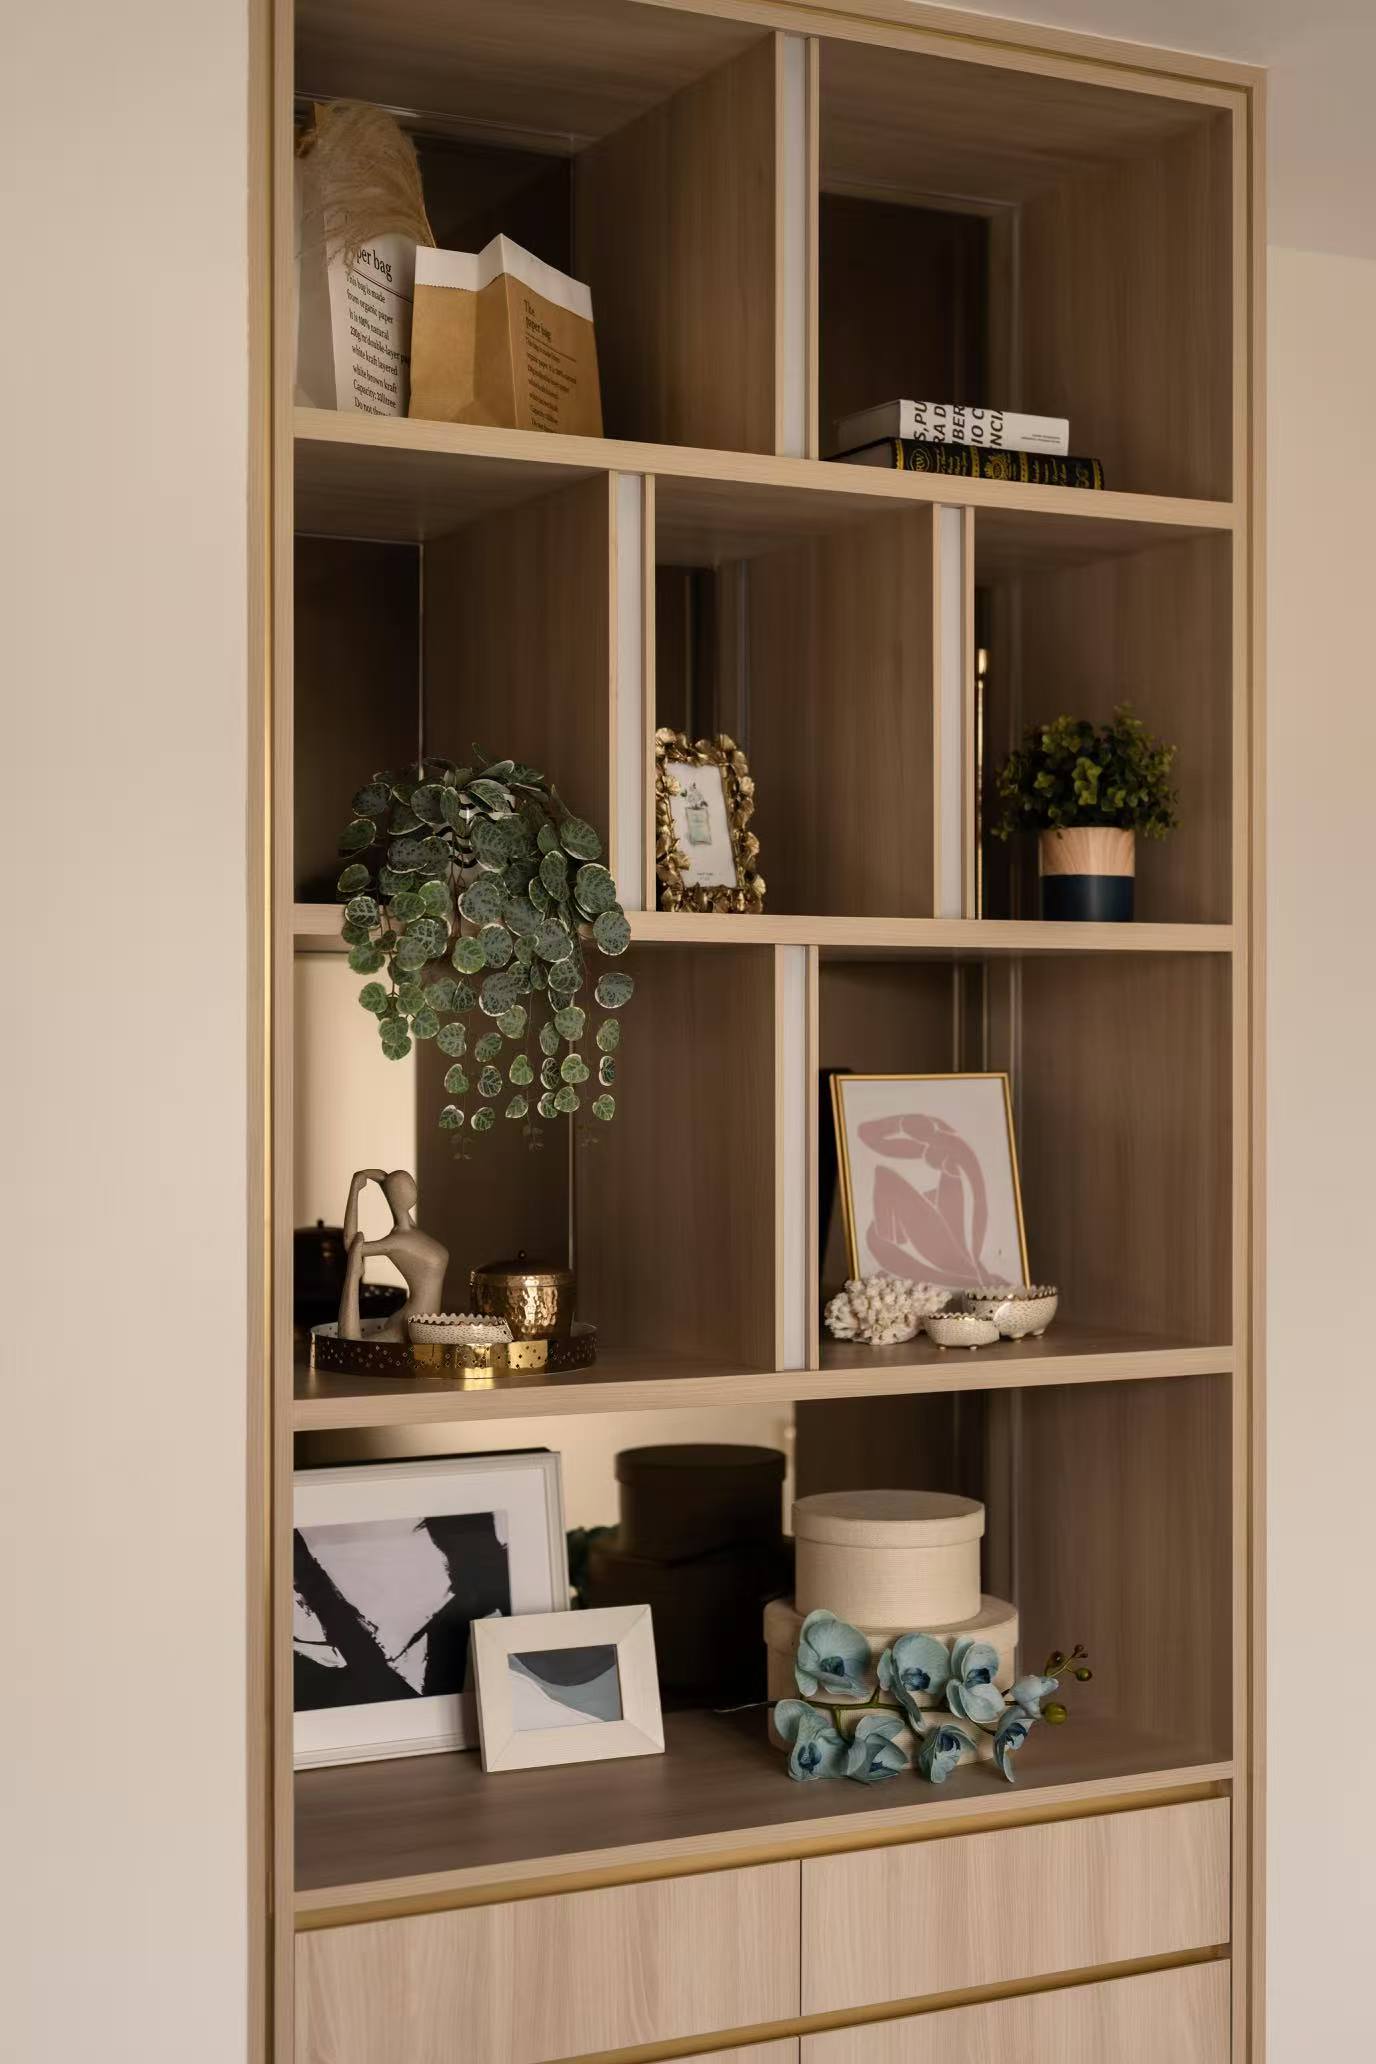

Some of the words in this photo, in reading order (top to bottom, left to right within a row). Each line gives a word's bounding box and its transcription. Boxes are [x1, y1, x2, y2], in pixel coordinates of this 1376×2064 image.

[373, 249, 393, 283] bag
[346, 289, 359, 304] from
[360, 300, 377, 317] organic
[378, 311, 393, 325] paper
[371, 290, 386, 303] made
[523, 298, 537, 318] The
[371, 324, 390, 341] natural
[352, 344, 366, 360] white
[366, 350, 377, 366] kraft
[378, 357, 397, 376] layered
[353, 364, 366, 379] white
[366, 370, 383, 387] brown
[383, 378, 397, 394] kraft
[355, 397, 362, 410] Do
